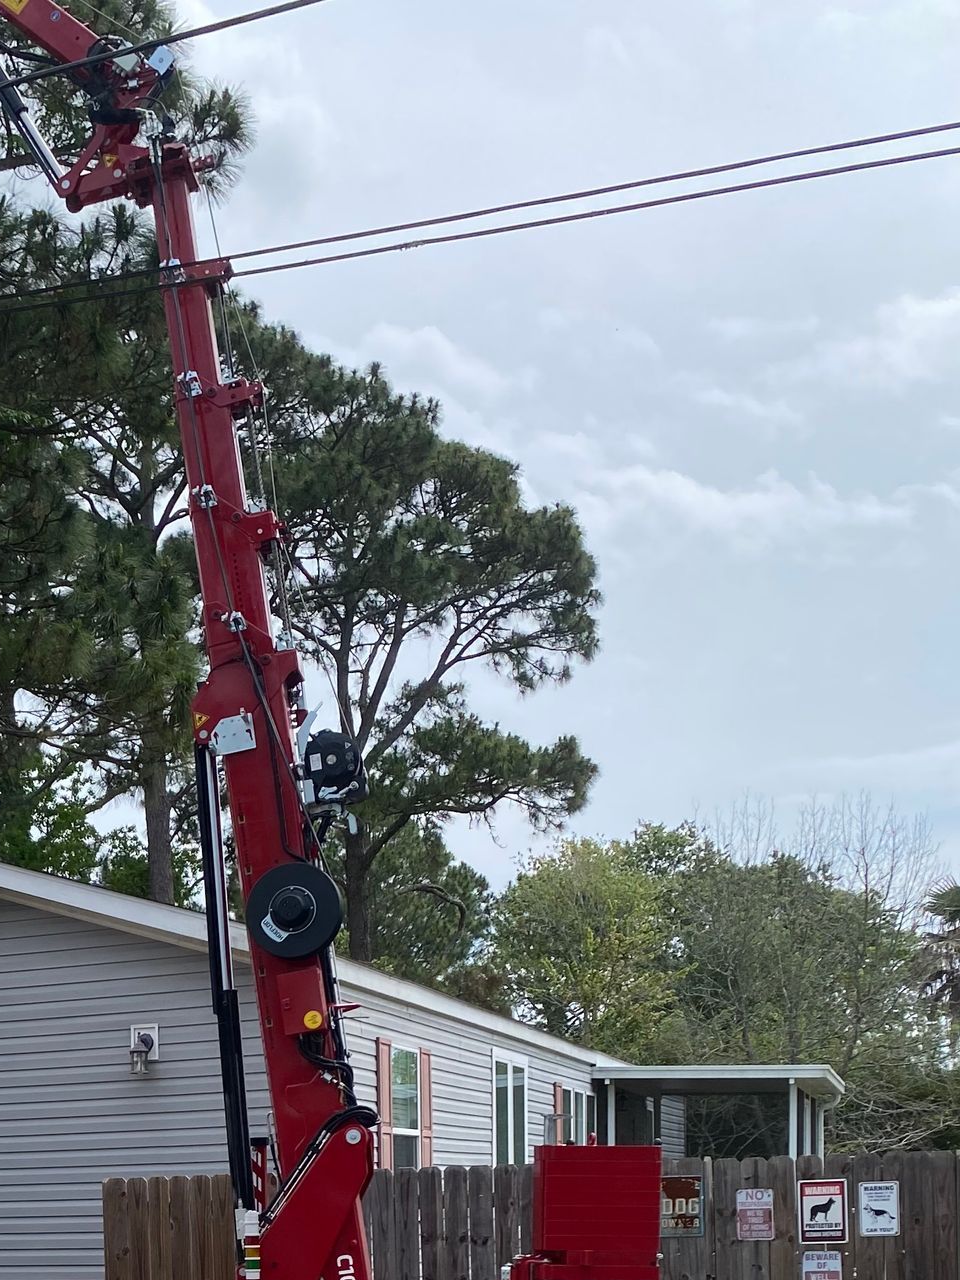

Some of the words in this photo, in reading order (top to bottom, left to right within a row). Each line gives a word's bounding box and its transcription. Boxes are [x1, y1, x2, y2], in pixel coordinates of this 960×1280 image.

[262, 919, 284, 941] HOEFLON
[745, 1190, 765, 1201] NO
[805, 1186, 841, 1195] WARNING
[662, 1197, 700, 1215] DOG
[805, 1253, 840, 1261] BEWARE
[816, 1261, 828, 1269] OF
